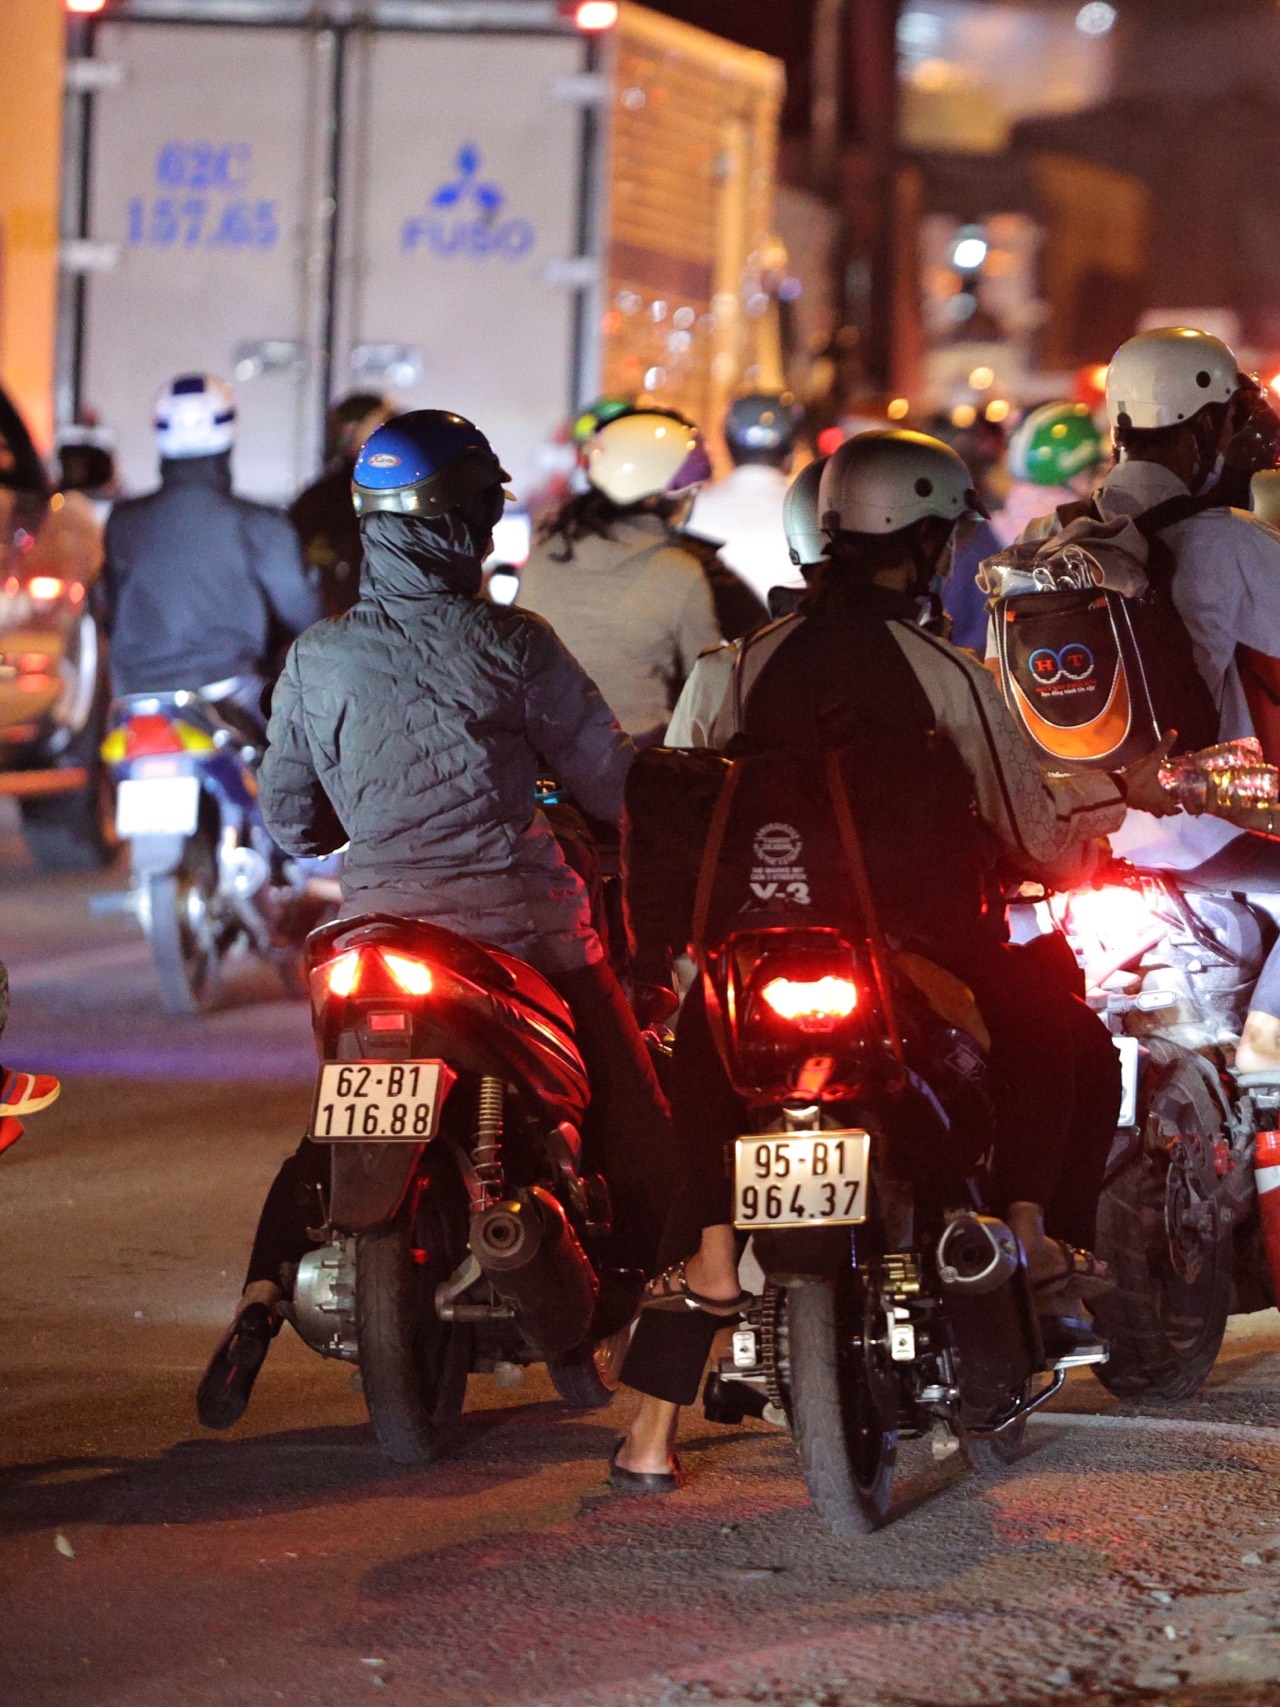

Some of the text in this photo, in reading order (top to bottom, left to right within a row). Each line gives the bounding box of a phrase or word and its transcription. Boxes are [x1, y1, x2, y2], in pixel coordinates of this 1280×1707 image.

[401, 216, 537, 260] FUSO
[323, 1103, 430, 1135] 116.88
[755, 1141, 845, 1179] 95-B1
[742, 1181, 860, 1220] 964.37
